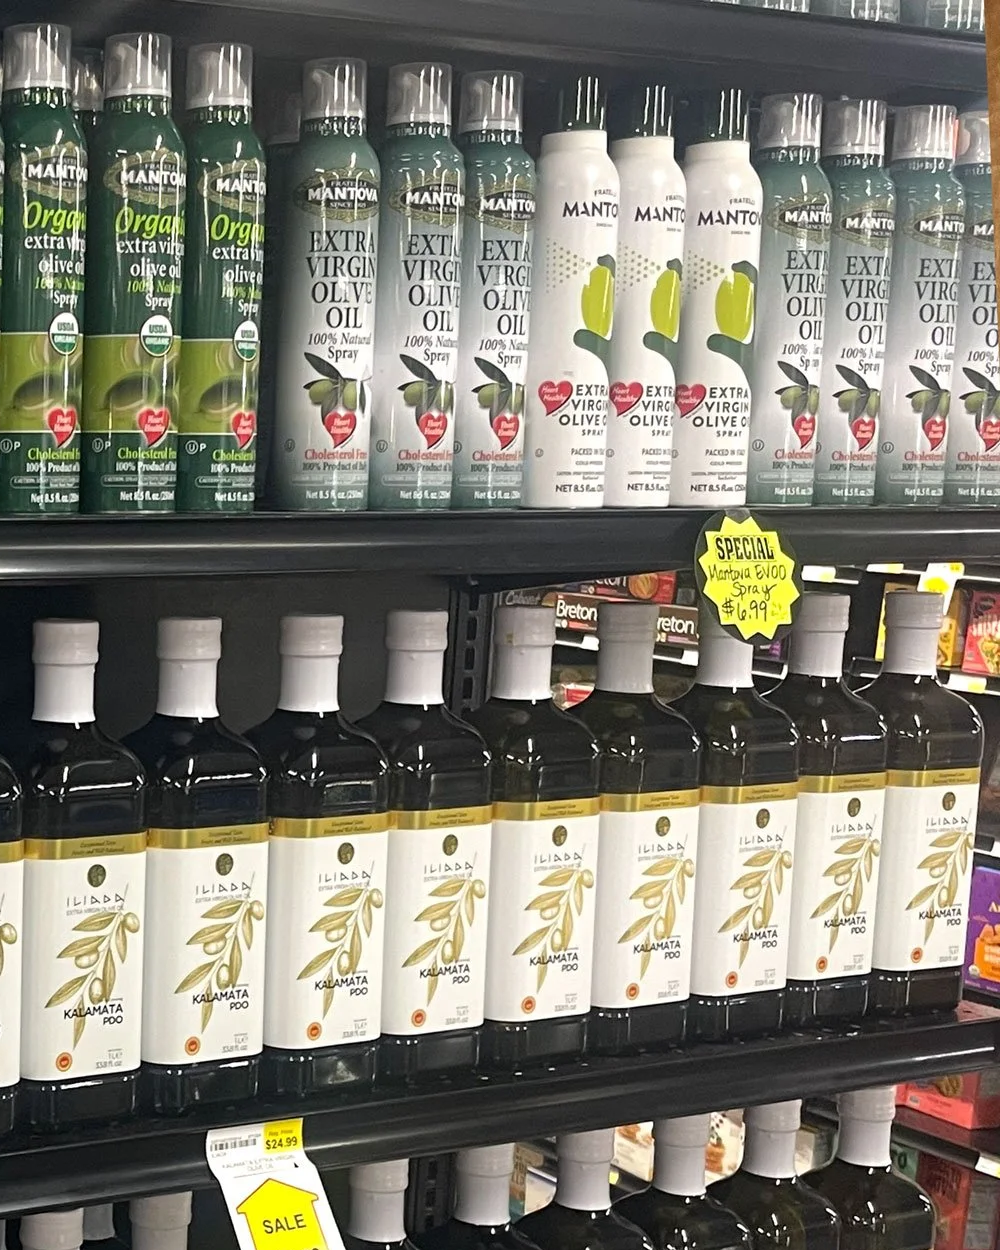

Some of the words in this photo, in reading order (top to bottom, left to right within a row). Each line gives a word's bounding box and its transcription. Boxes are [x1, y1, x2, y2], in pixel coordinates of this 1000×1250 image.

[308, 188, 378, 202] MANTOVA
[310, 231, 374, 252] EXTRA
[306, 256, 375, 278] VIRGIN
[311, 282, 372, 304] OLIVE
[326, 307, 362, 329] OIL
[423, 310, 453, 331] OIL
[497, 314, 526, 335] OIL
[308, 333, 337, 345] 100%
[341, 333, 371, 345] Natural
[328, 347, 358, 362] Spray
[709, 387, 748, 398] EXTRA
[705, 402, 748, 412] VIRGIN
[692, 416, 738, 428] OLIVE
[691, 484, 707, 492] NET
[709, 484, 719, 492] 8.5
[716, 536, 774, 560] SPECIAL
[709, 564, 750, 581] Mantova
[756, 564, 786, 580] EVOO
[732, 582, 776, 602] Spray
[556, 599, 597, 622] Breton
[722, 601, 767, 622] $6.99
[657, 615, 694, 635] reton
[926, 816, 968, 826] ILIADA
[424, 863, 472, 875] ILIADA
[196, 882, 251, 894] ILIADA
[919, 908, 962, 920] KALAMATA
[420, 964, 470, 978] KALAMATA
[193, 990, 249, 1005] KALAMATA
[266, 1136, 297, 1150] $24.99
[263, 1214, 306, 1234] SALE
